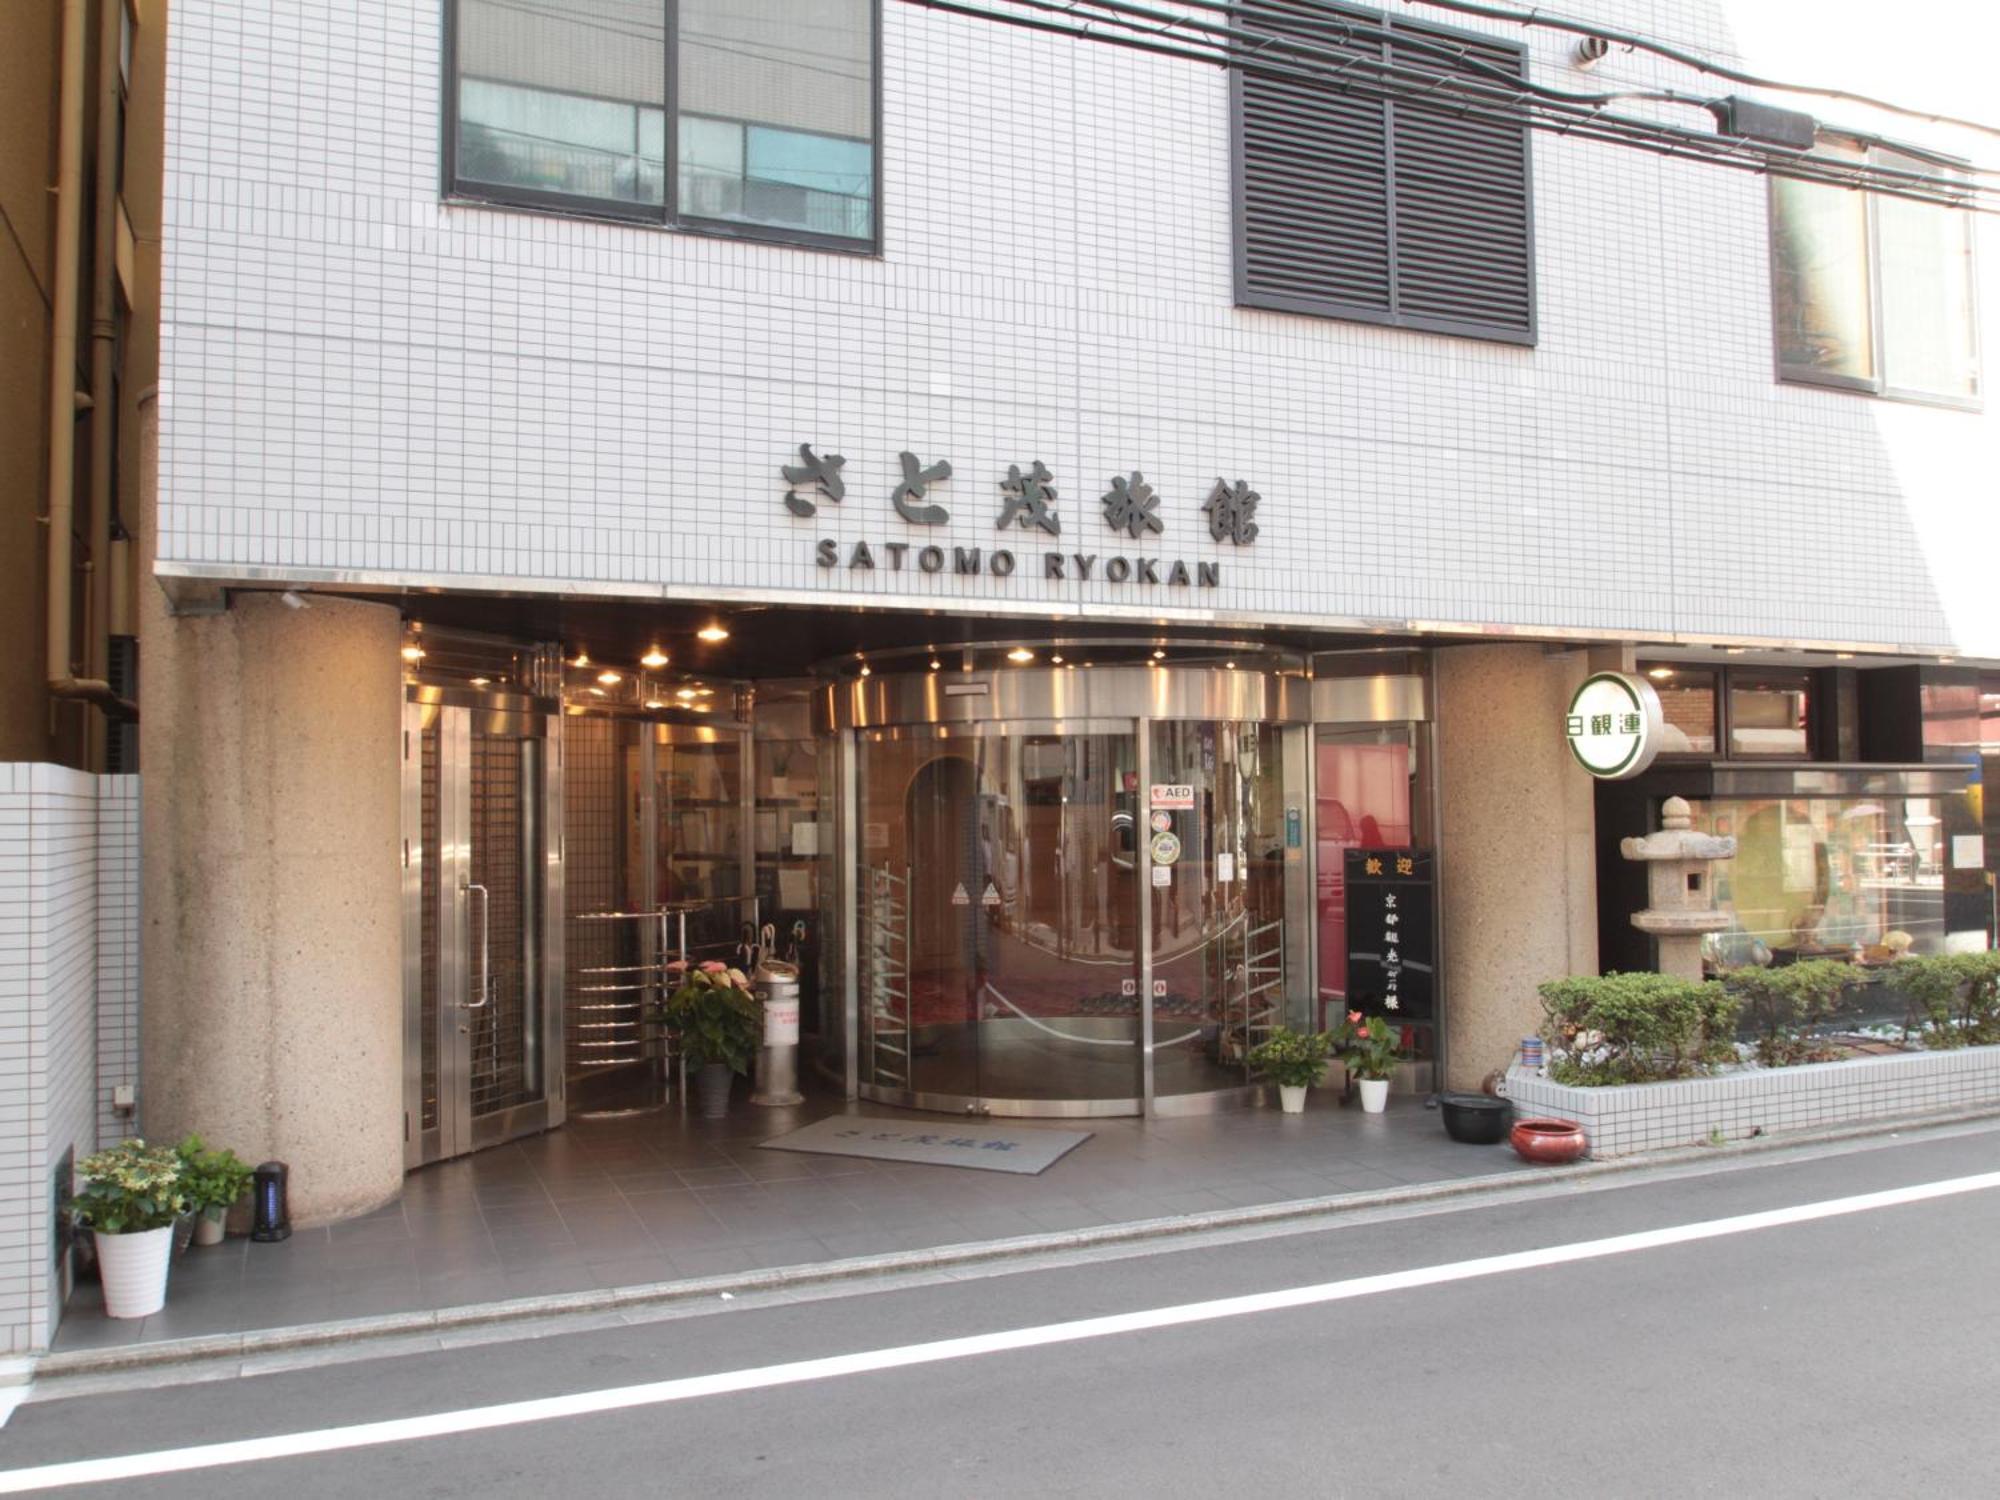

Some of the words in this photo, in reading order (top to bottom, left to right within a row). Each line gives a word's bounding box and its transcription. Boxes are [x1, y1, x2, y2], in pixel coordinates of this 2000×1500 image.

[781, 442, 1263, 546] さと茂旅館
[816, 538, 1016, 577] SATOMO
[1045, 551, 1221, 588] RYOKAN
[1566, 712, 1641, 736] 日観連
[1165, 786, 1191, 798] AED
